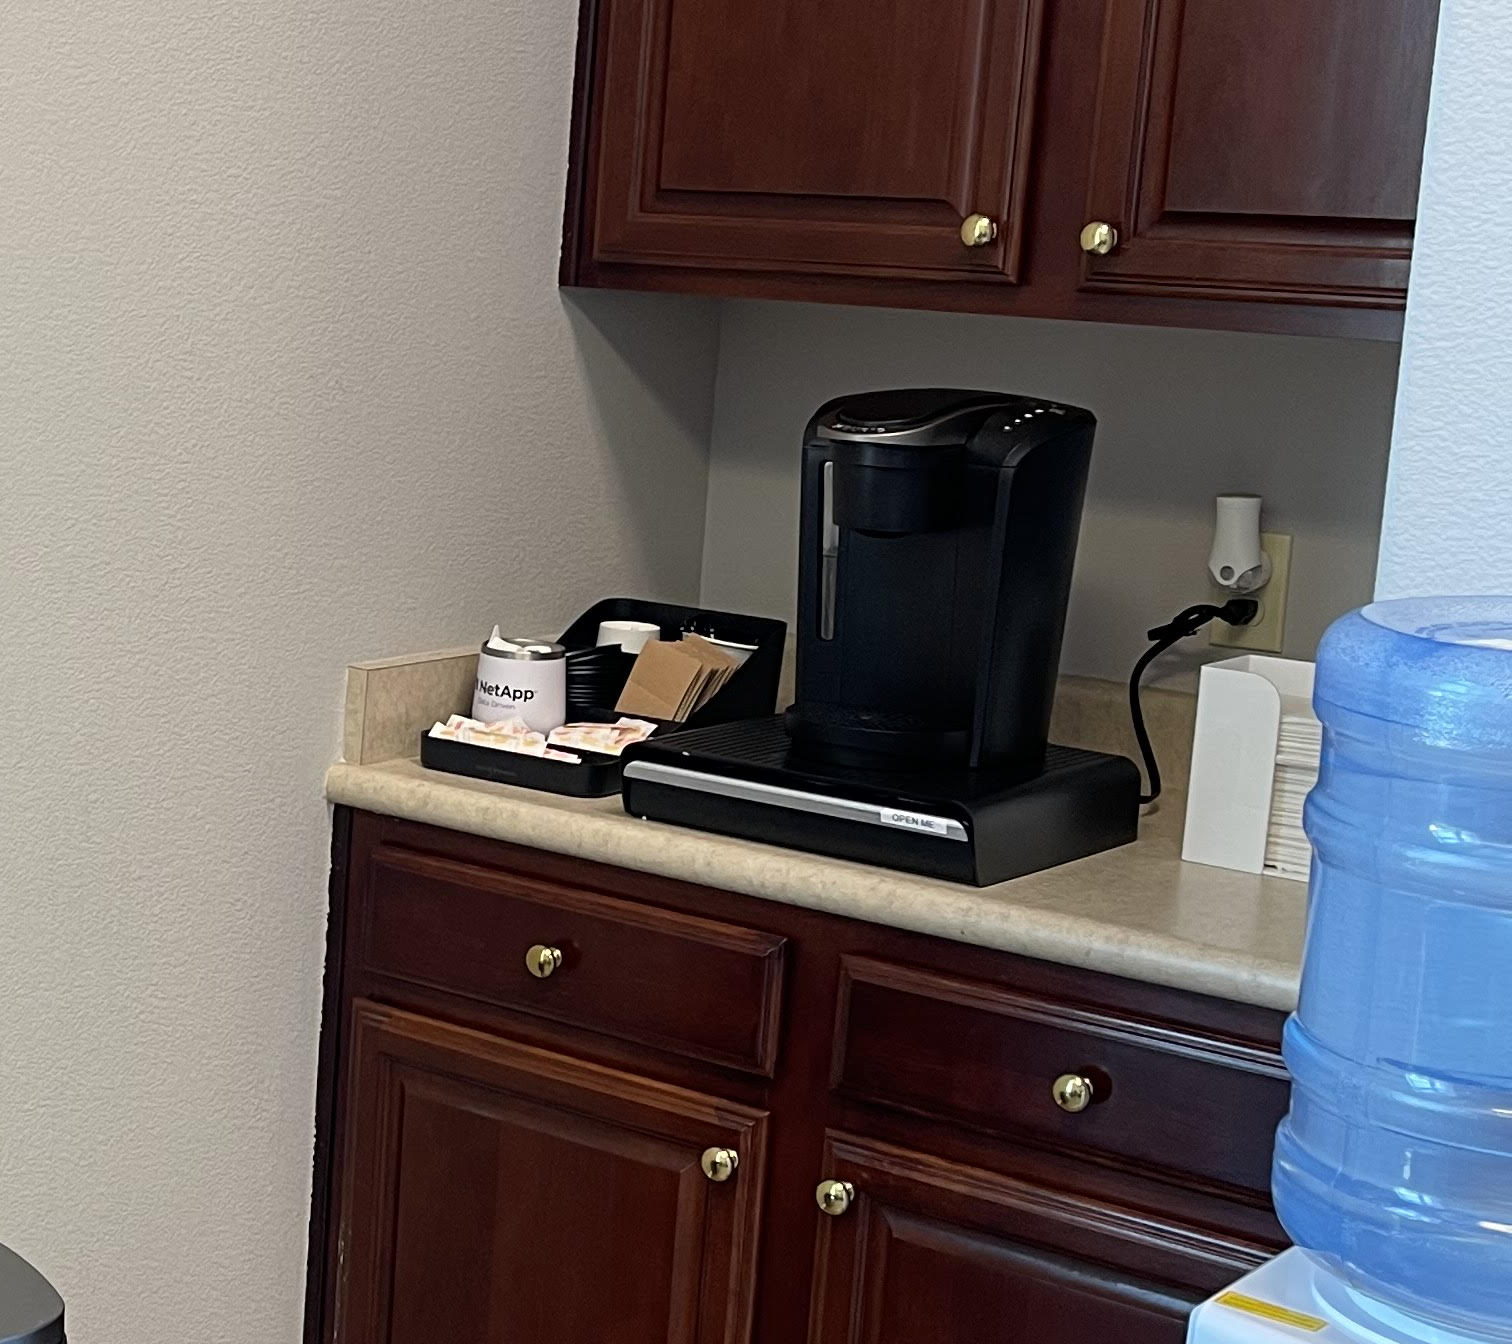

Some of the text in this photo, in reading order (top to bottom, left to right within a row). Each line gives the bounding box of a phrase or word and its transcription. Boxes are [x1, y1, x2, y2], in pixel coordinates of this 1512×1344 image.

[479, 679, 535, 703] NetApp
[891, 814, 935, 828] OPEN ME
